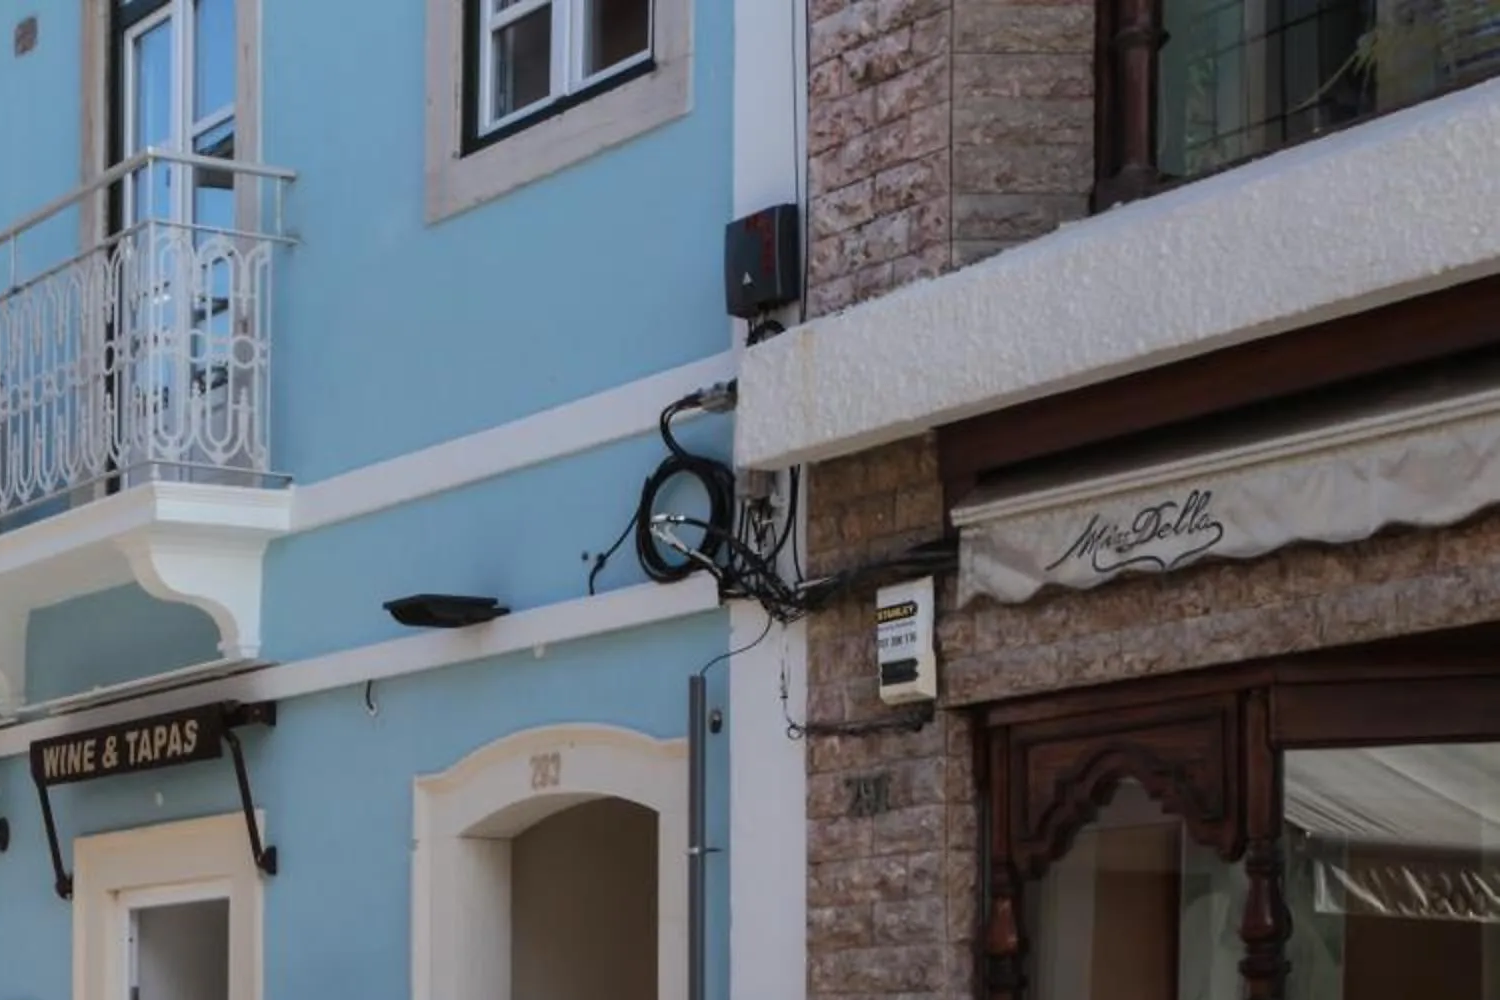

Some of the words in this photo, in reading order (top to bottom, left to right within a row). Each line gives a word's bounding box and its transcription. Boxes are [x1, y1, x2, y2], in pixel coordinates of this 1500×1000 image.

[43, 739, 96, 778] WINE
[102, 735, 119, 769] &
[125, 719, 199, 766] TAPAS
